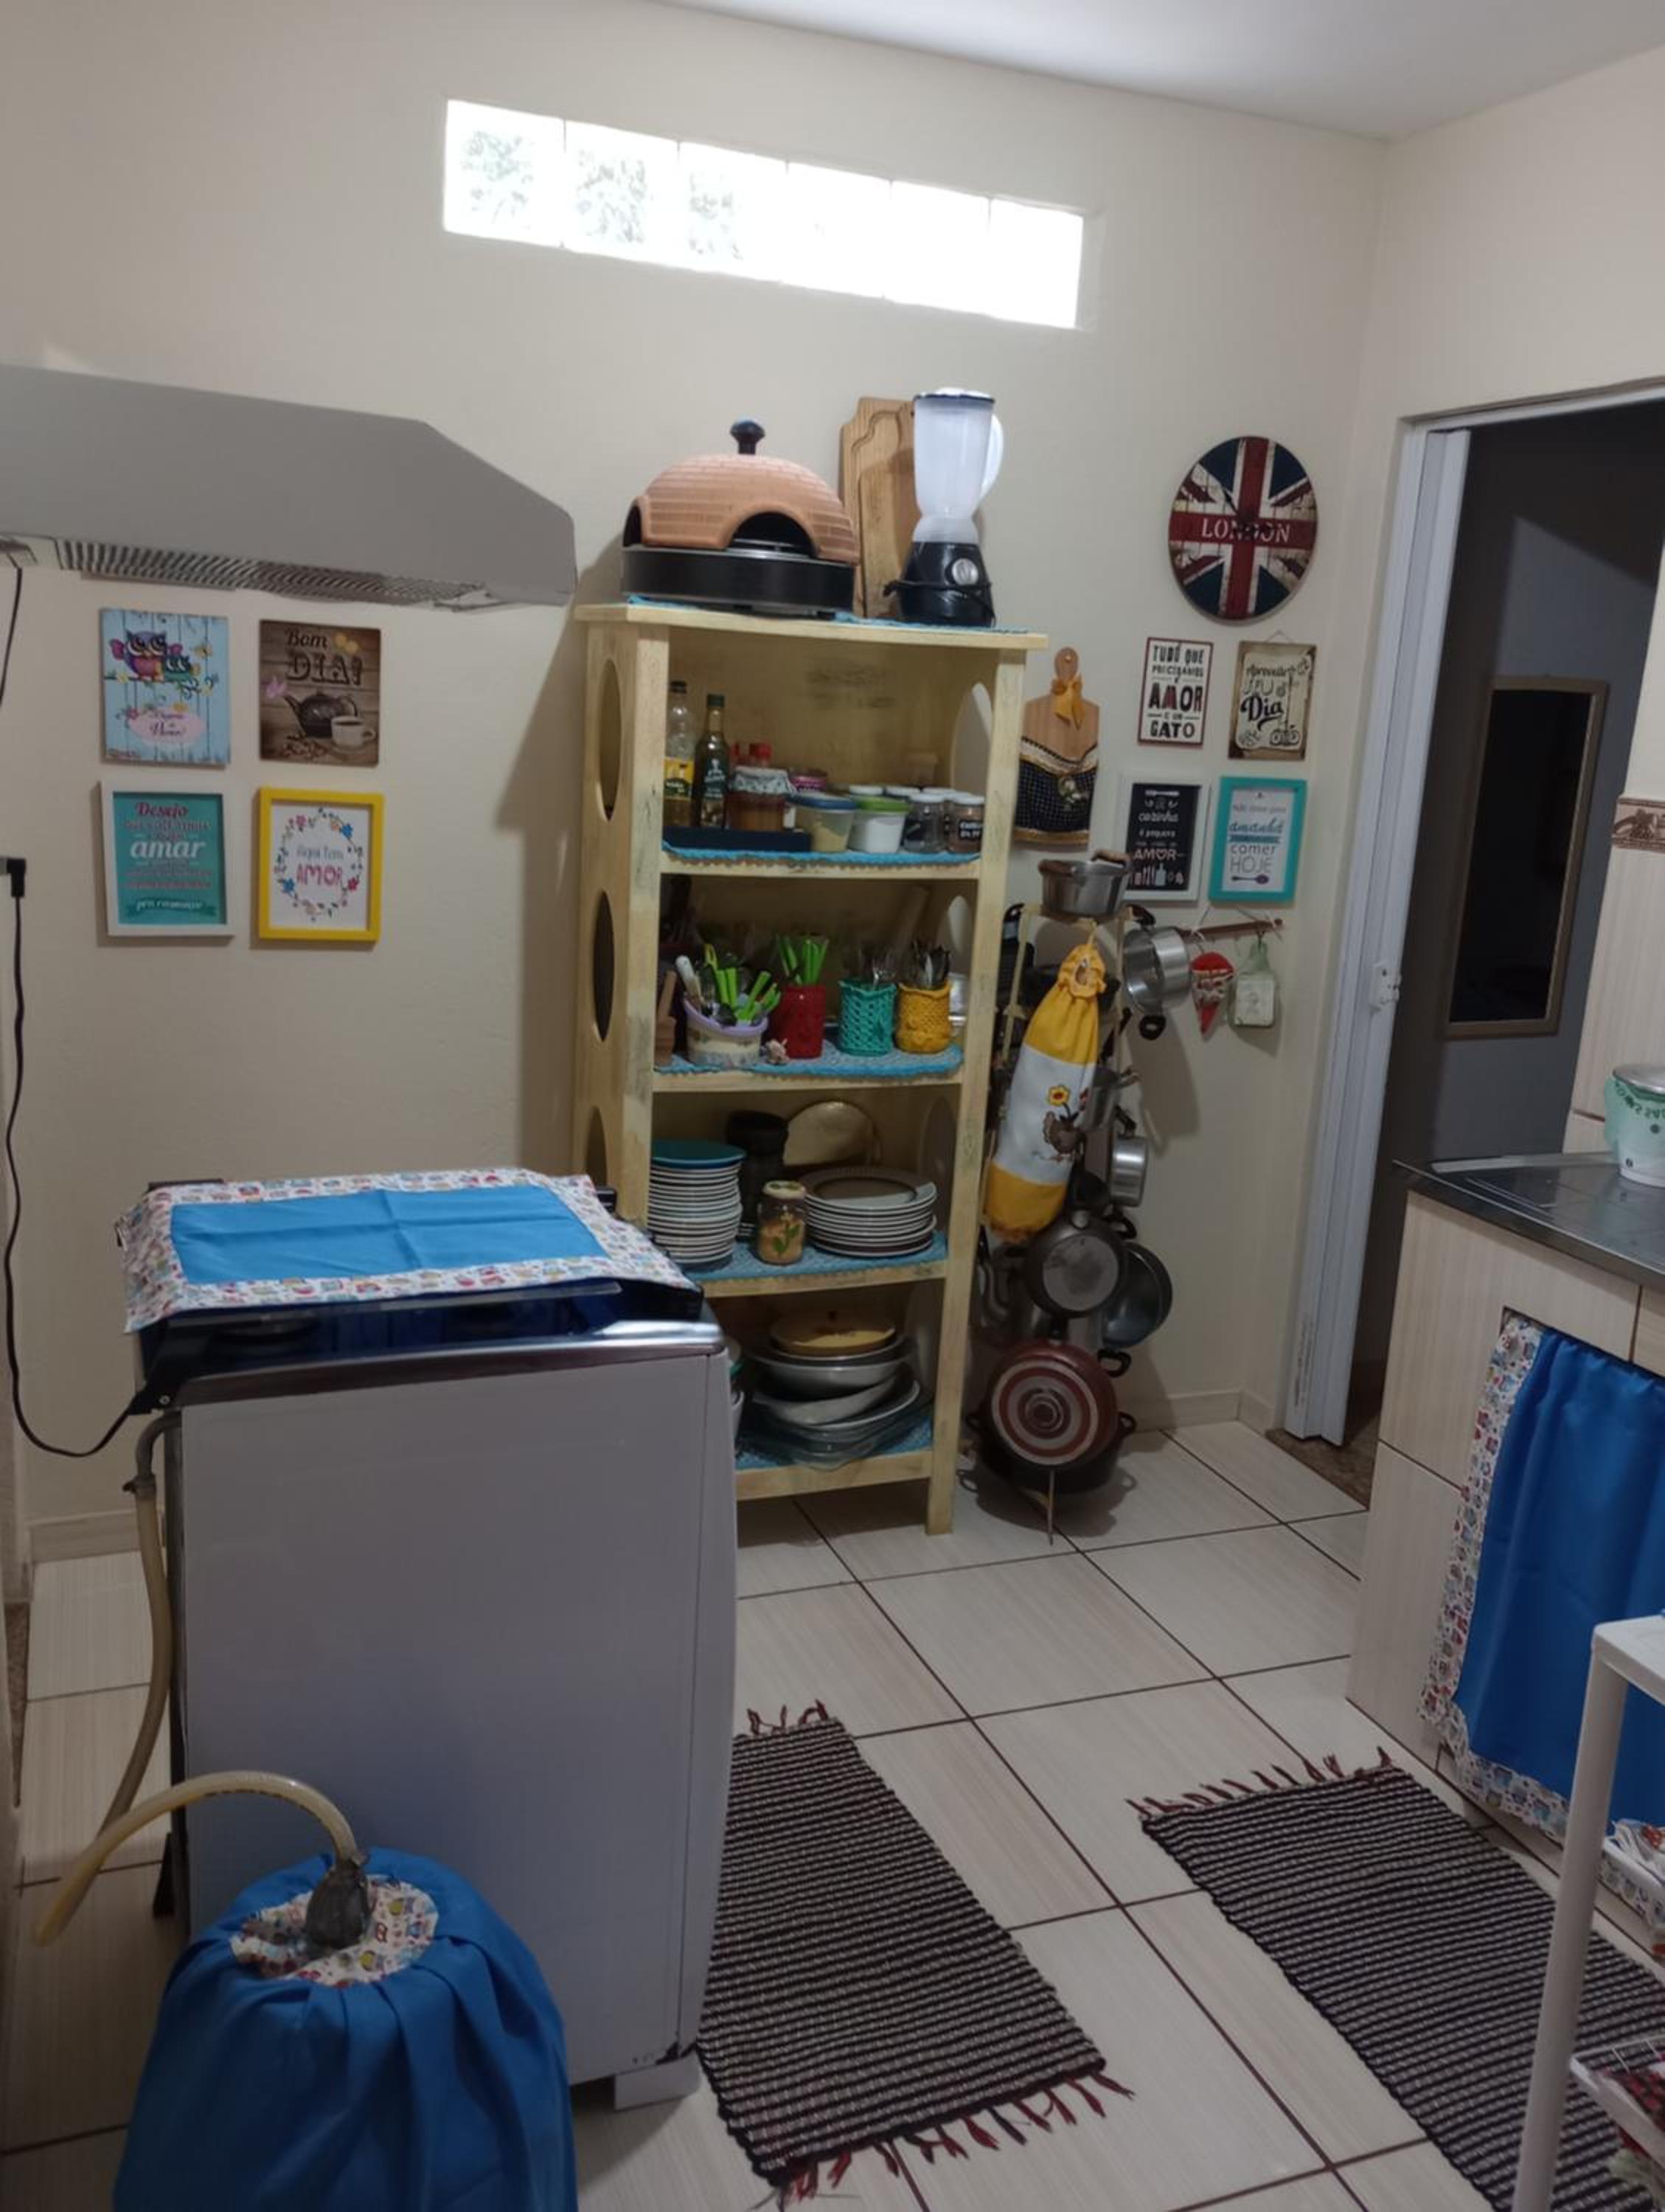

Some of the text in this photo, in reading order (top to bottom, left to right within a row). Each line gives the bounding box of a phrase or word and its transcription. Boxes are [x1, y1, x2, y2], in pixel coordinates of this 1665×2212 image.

[285, 627, 328, 650] Bom
[1153, 644, 1204, 665] TUDO QUE
[285, 651, 364, 686] DIA!
[1148, 683, 1203, 714] AMOR
[1240, 694, 1285, 723] Dia
[1150, 720, 1195, 739] GATO
[129, 840, 207, 860] amar
[1229, 844, 1276, 855] comer
[296, 863, 343, 886] AMOR
[1229, 856, 1273, 874] HOJE
